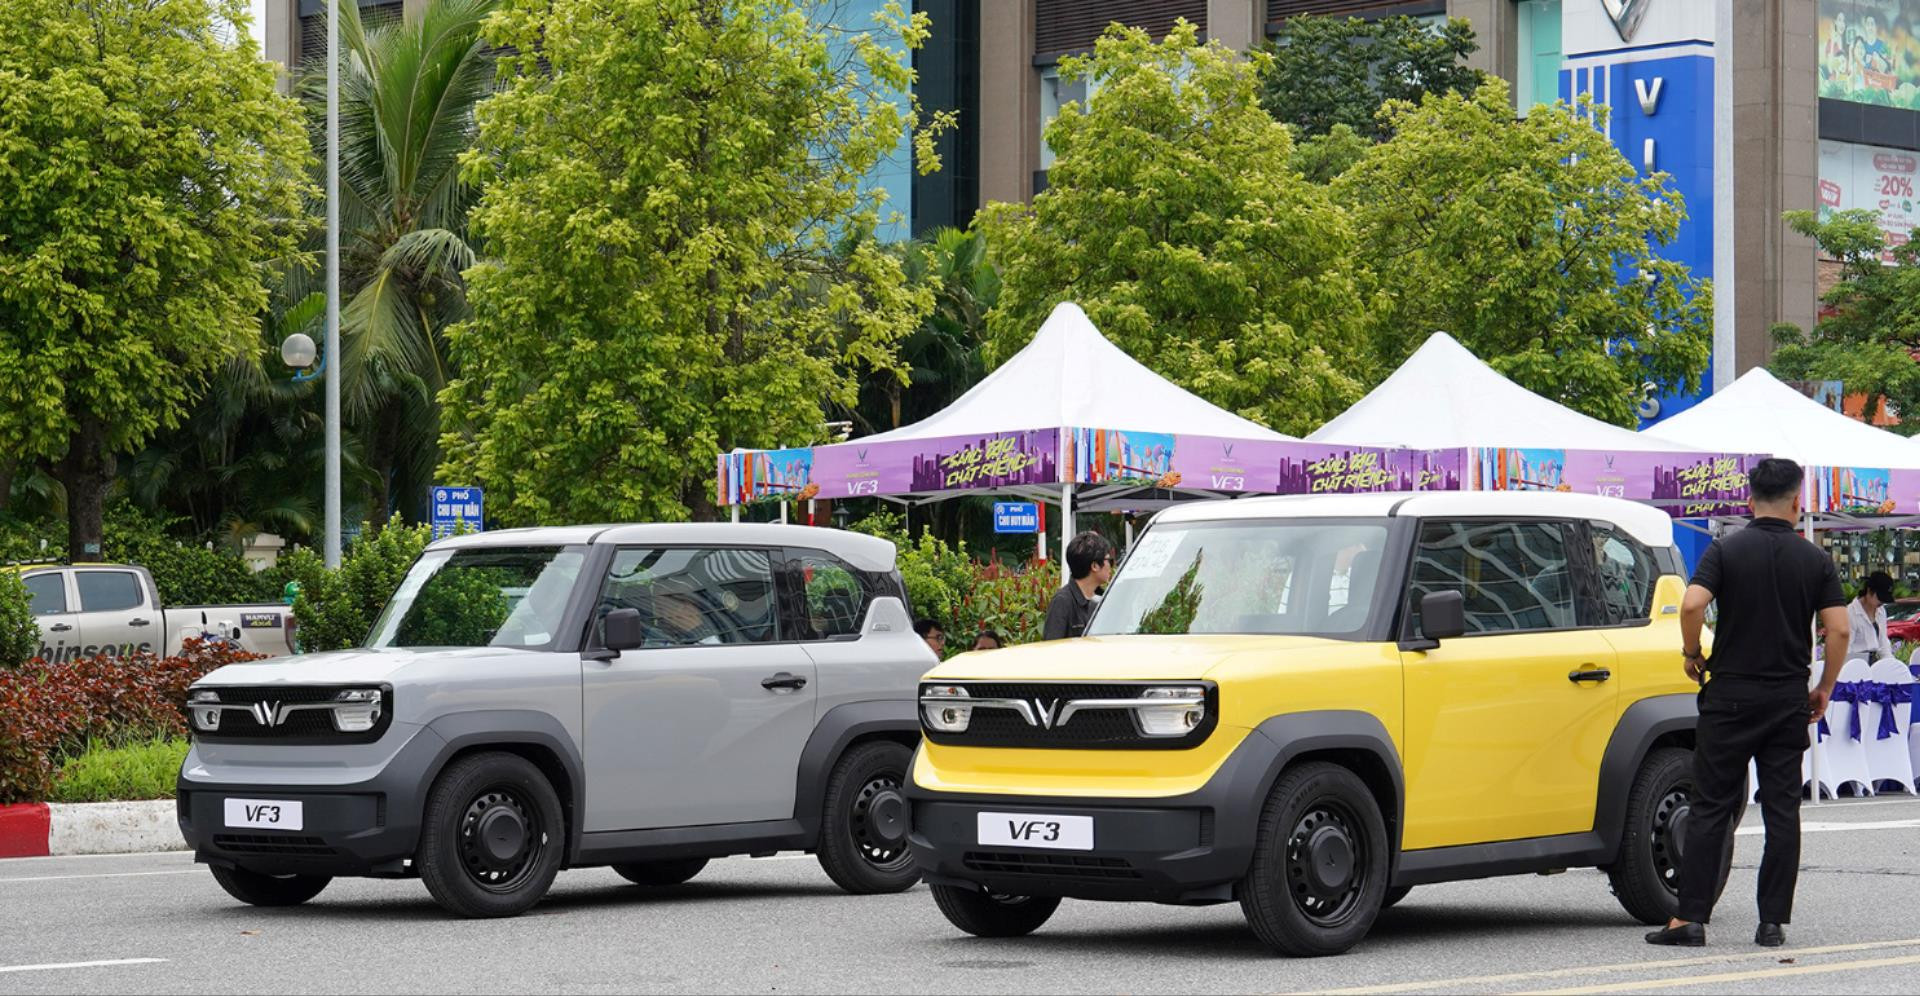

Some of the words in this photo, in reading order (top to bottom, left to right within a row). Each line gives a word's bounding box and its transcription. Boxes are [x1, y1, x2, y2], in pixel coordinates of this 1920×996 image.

[1881, 175, 1912, 198] 20%
[847, 480, 878, 494] VF3
[1211, 475, 1244, 490] VF3
[437, 503, 450, 517] CHU
[450, 503, 464, 517] HUY
[999, 515, 1010, 526] CHU
[1010, 515, 1021, 526] HUY
[245, 804, 280, 823] VF3
[1008, 820, 1060, 842] VF3
